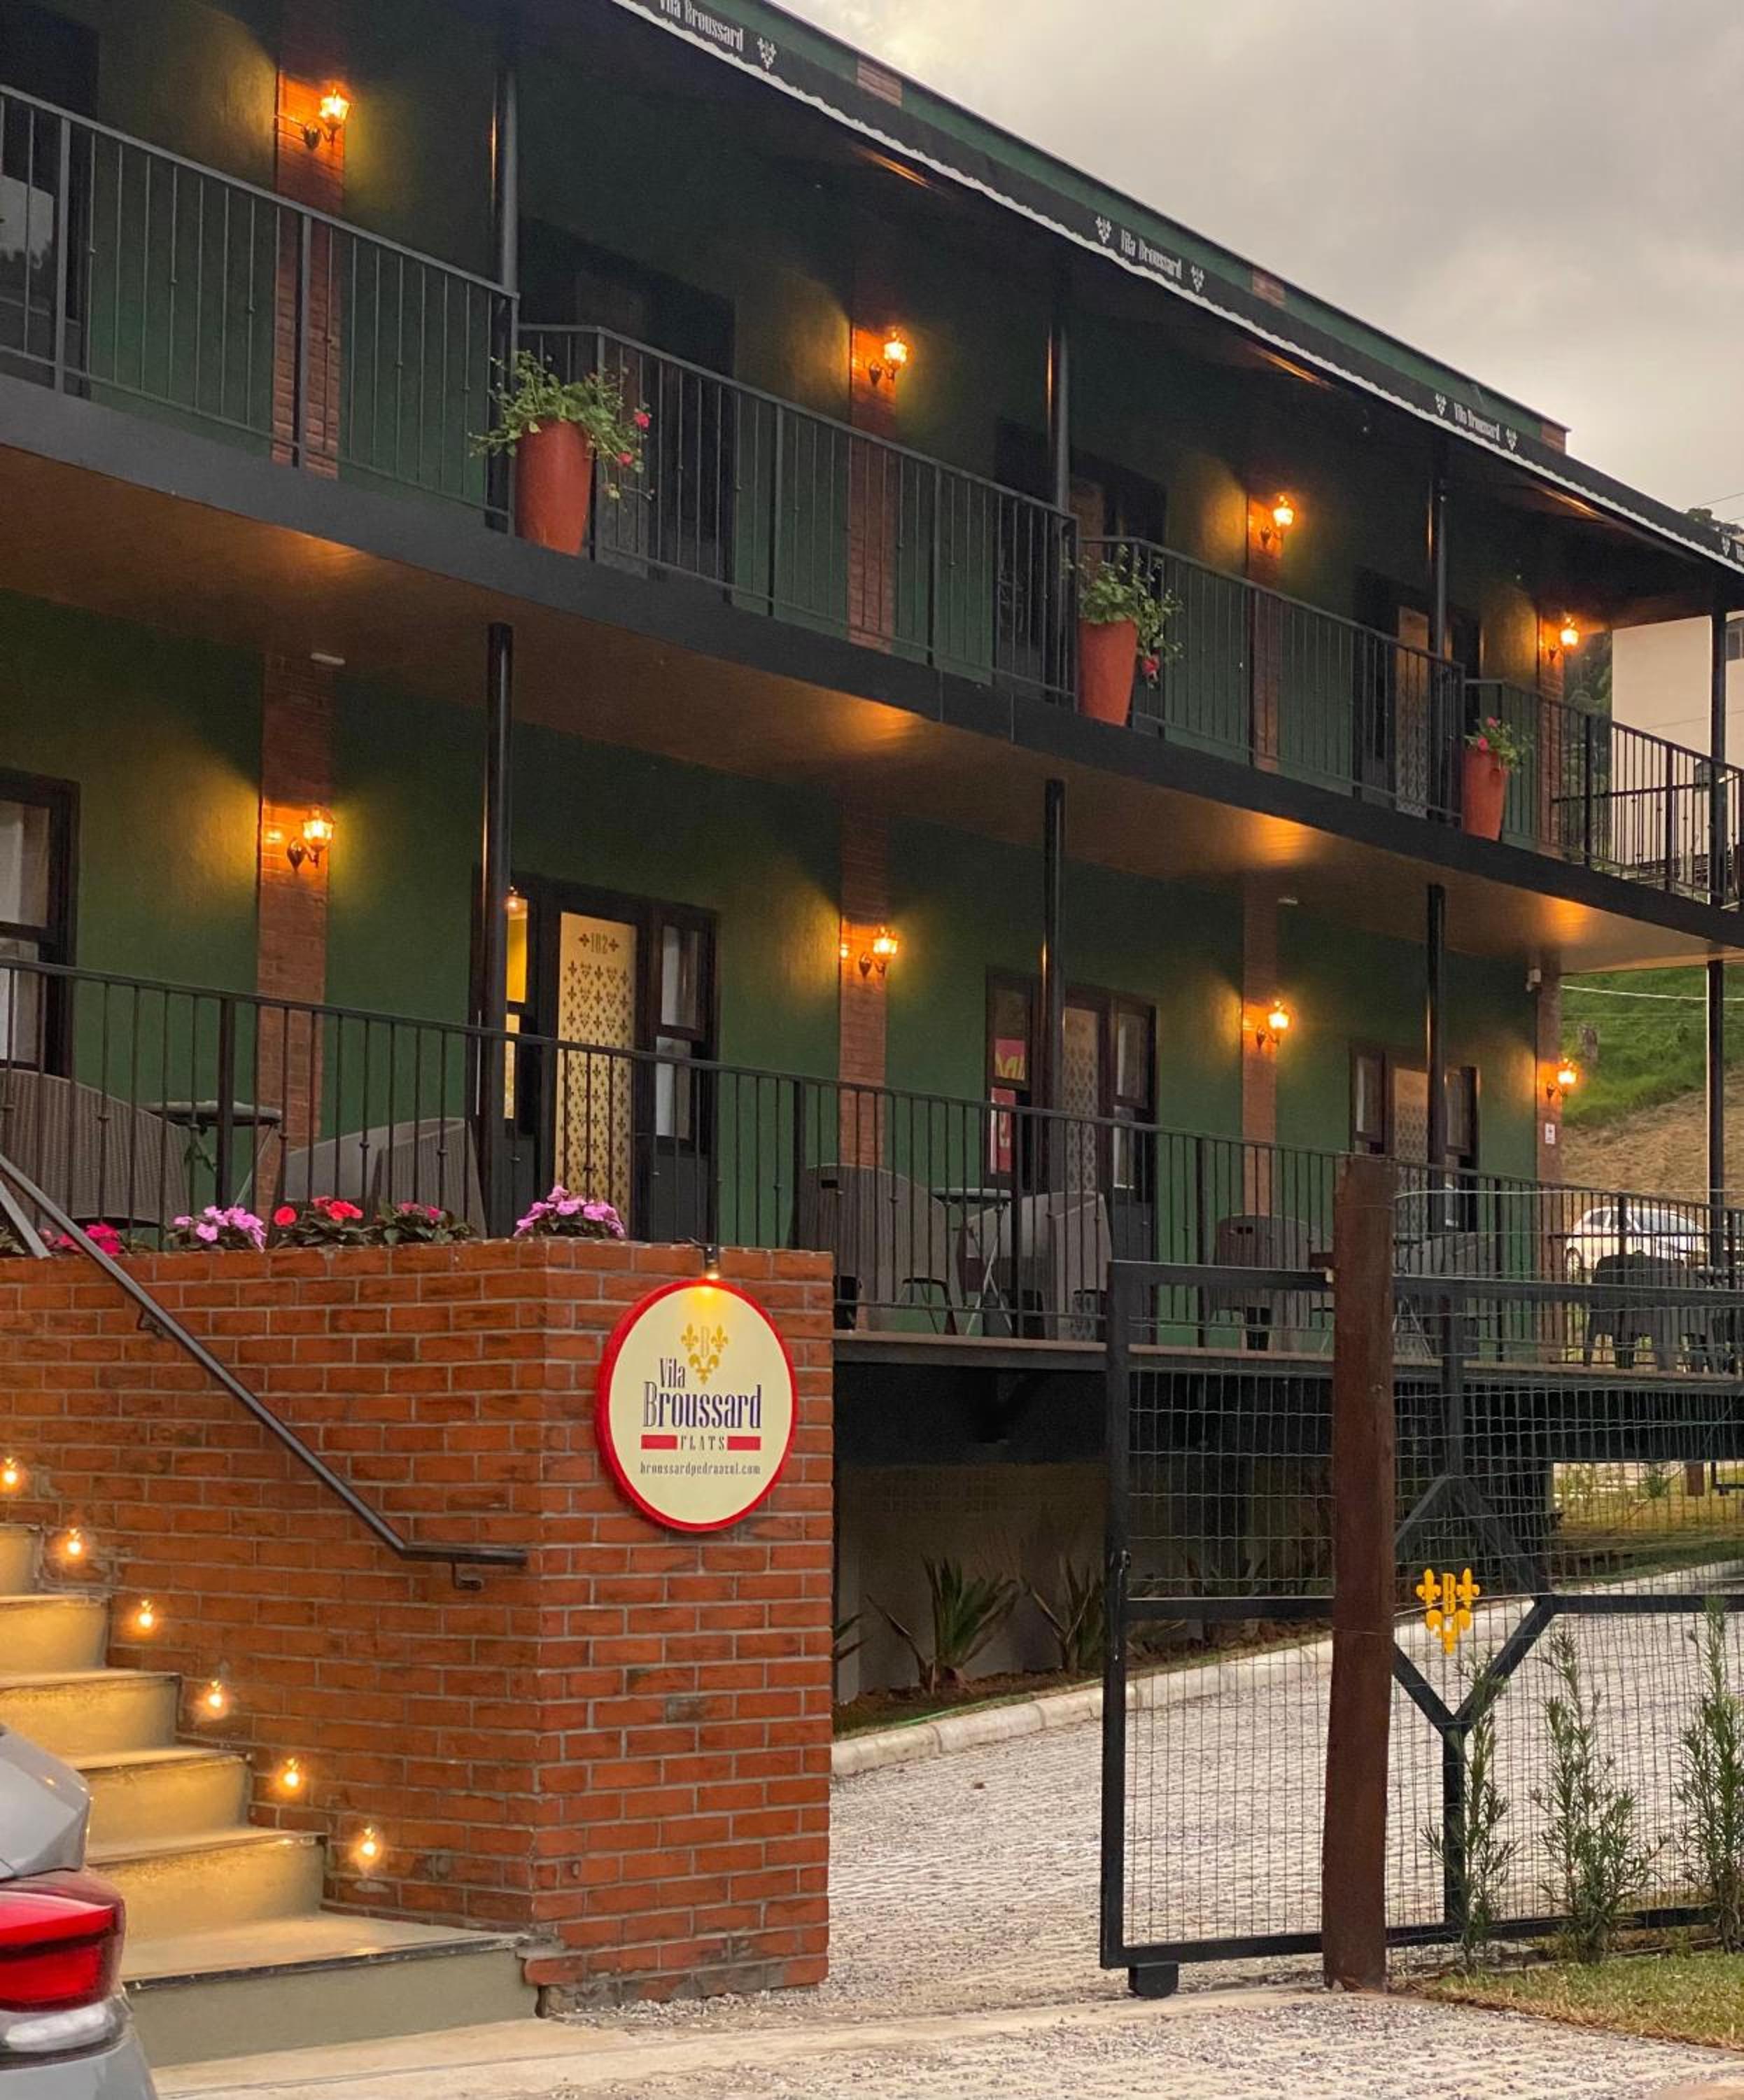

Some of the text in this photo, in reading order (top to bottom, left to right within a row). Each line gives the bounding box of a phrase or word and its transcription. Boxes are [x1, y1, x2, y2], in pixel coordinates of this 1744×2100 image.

[660, 1358, 685, 1388] Vila
[643, 1381, 761, 1429] Broussard
[681, 1435, 724, 1450] FLATS
